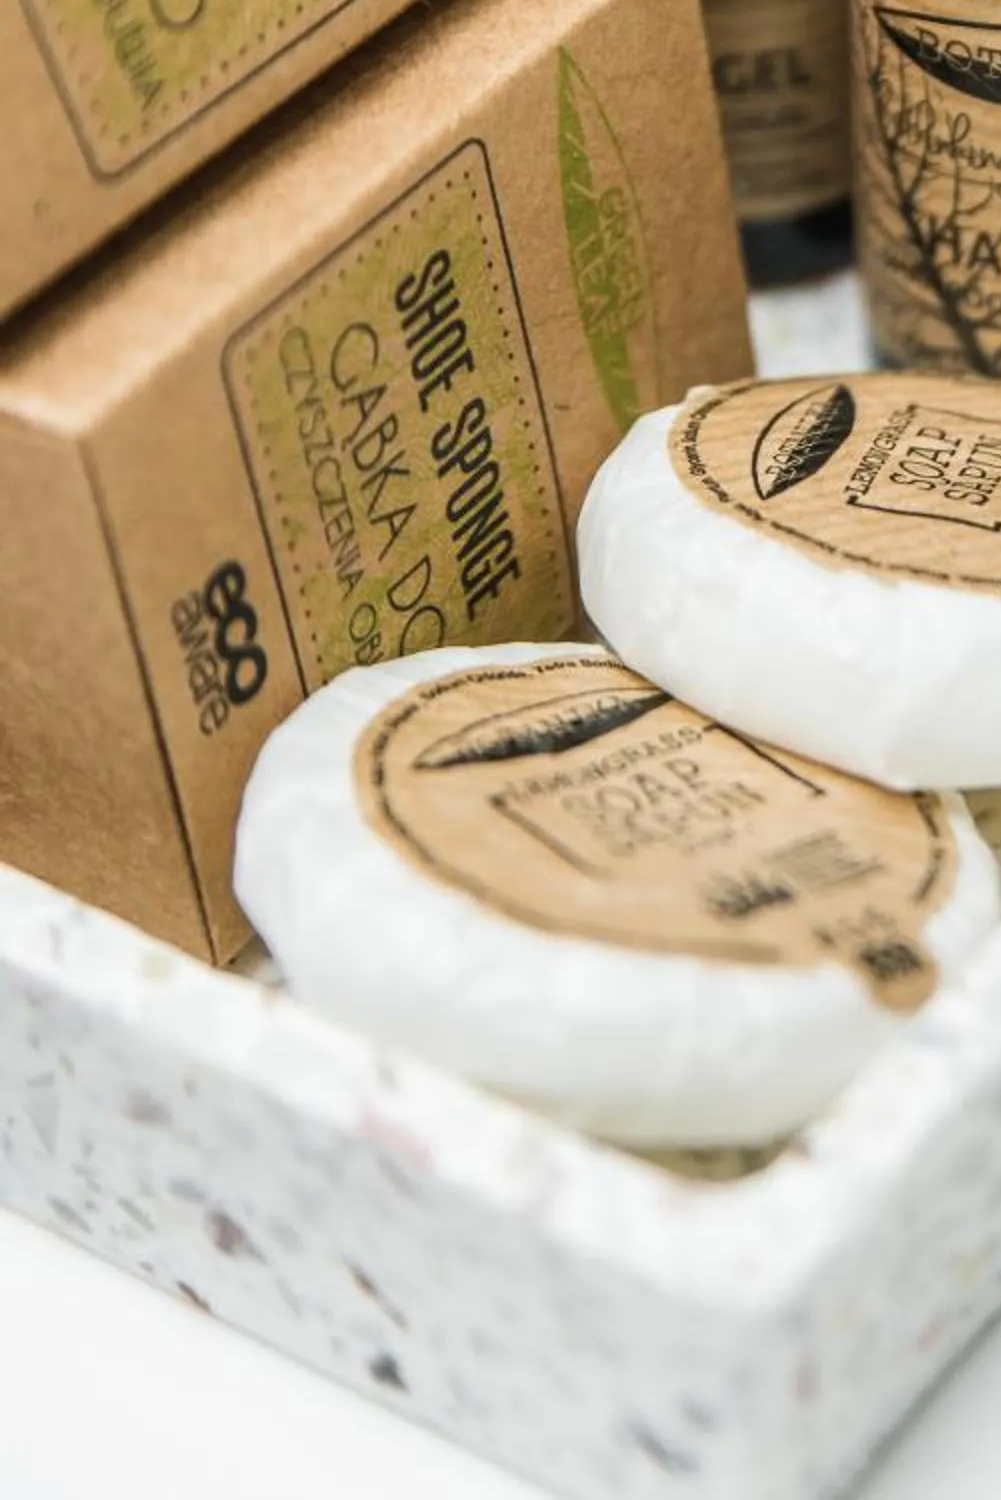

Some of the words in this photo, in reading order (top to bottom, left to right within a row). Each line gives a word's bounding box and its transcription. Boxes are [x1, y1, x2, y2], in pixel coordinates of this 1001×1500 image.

[394, 249, 475, 412] SHOE
[431, 399, 523, 622] SPONGE
[889, 425, 962, 491] SOAP
[171, 590, 231, 736] aware
[204, 559, 267, 706] eco
